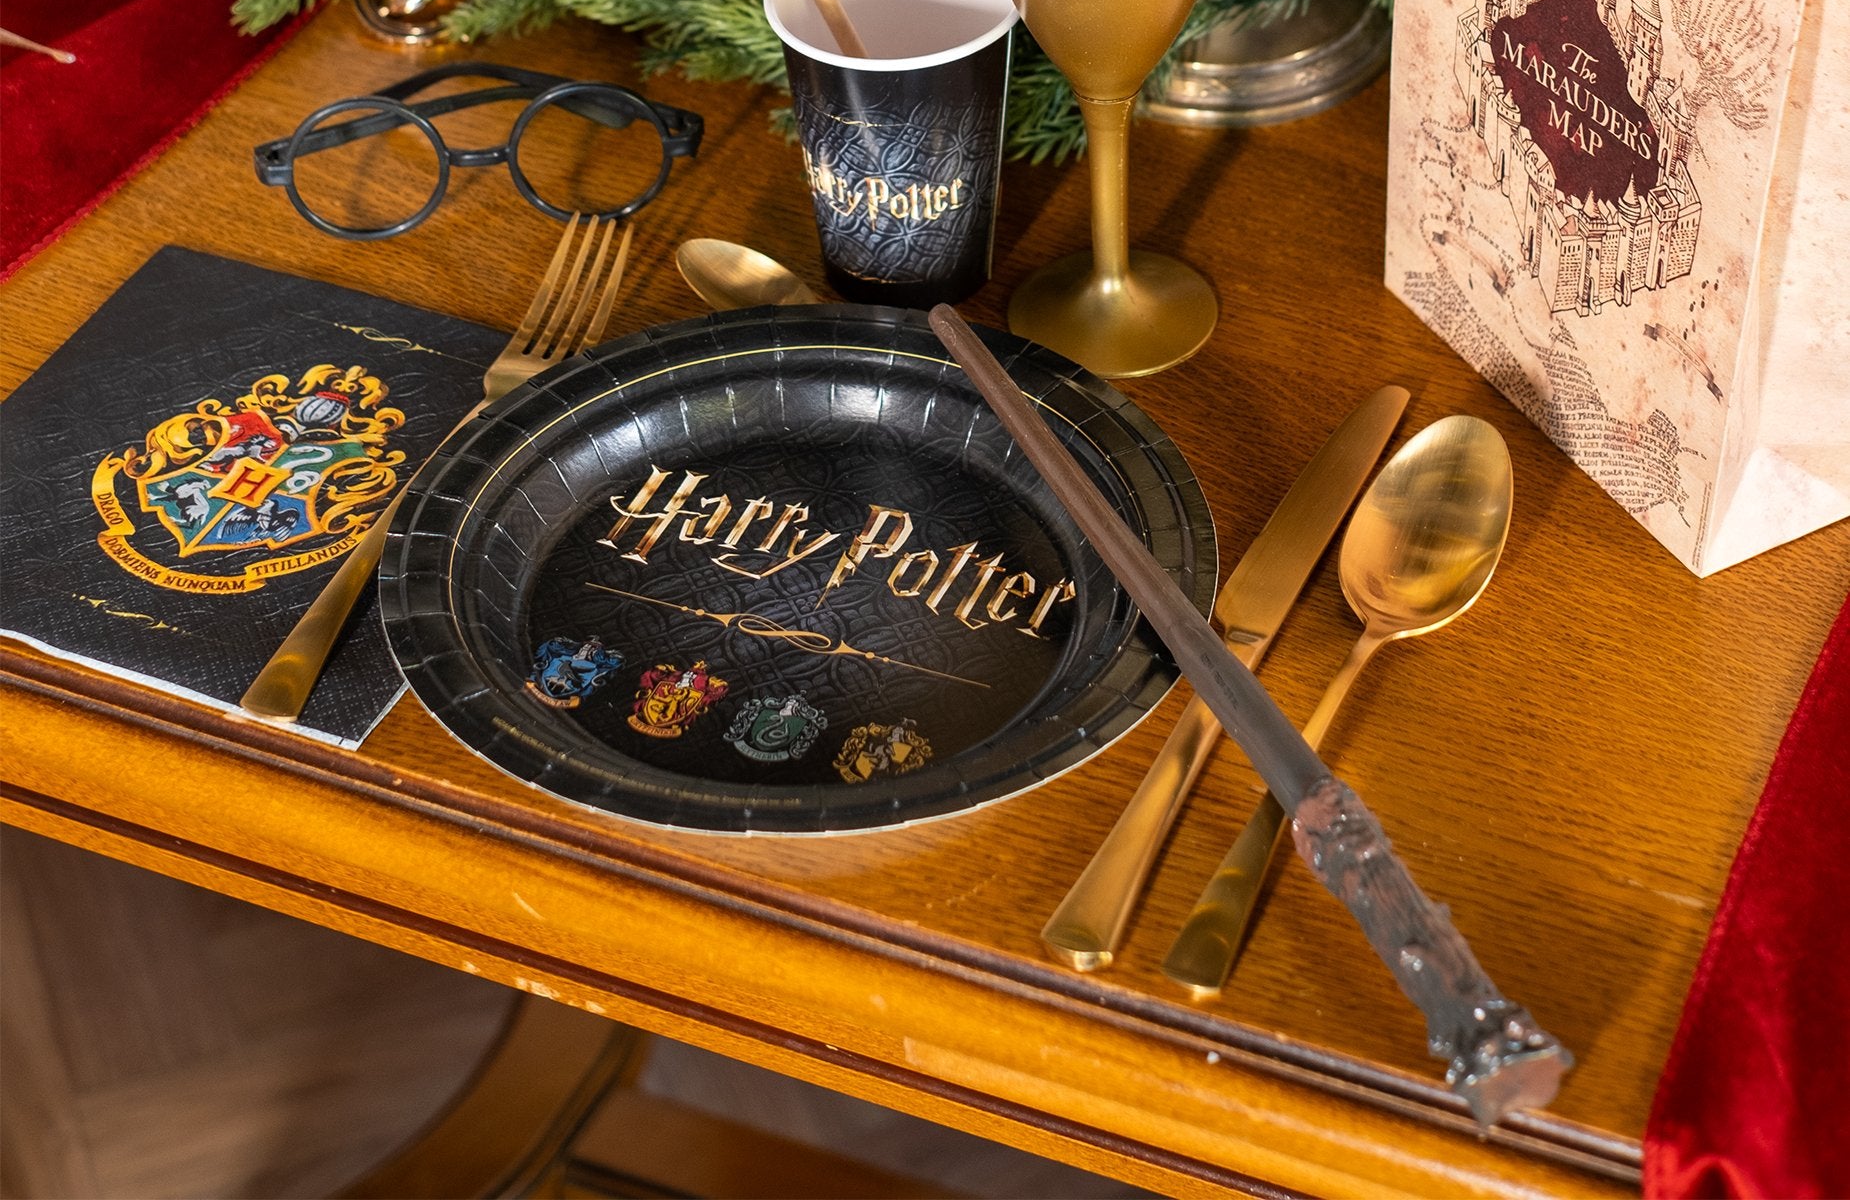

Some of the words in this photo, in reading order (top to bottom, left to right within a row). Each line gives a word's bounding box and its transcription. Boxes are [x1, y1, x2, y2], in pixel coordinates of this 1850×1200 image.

[1561, 42, 1600, 85] The
[1500, 30, 1653, 161] MARAUDER'S
[1547, 98, 1604, 158] MAP
[864, 177, 964, 232] Potter
[97, 491, 125, 525] DRACO
[223, 466, 273, 502] H
[104, 536, 162, 580] DORMIENS
[162, 574, 247, 592] NUNQUAM
[251, 535, 358, 576] TITILLANDUS
[596, 464, 841, 580] Harry
[815, 504, 1079, 640] Potter
